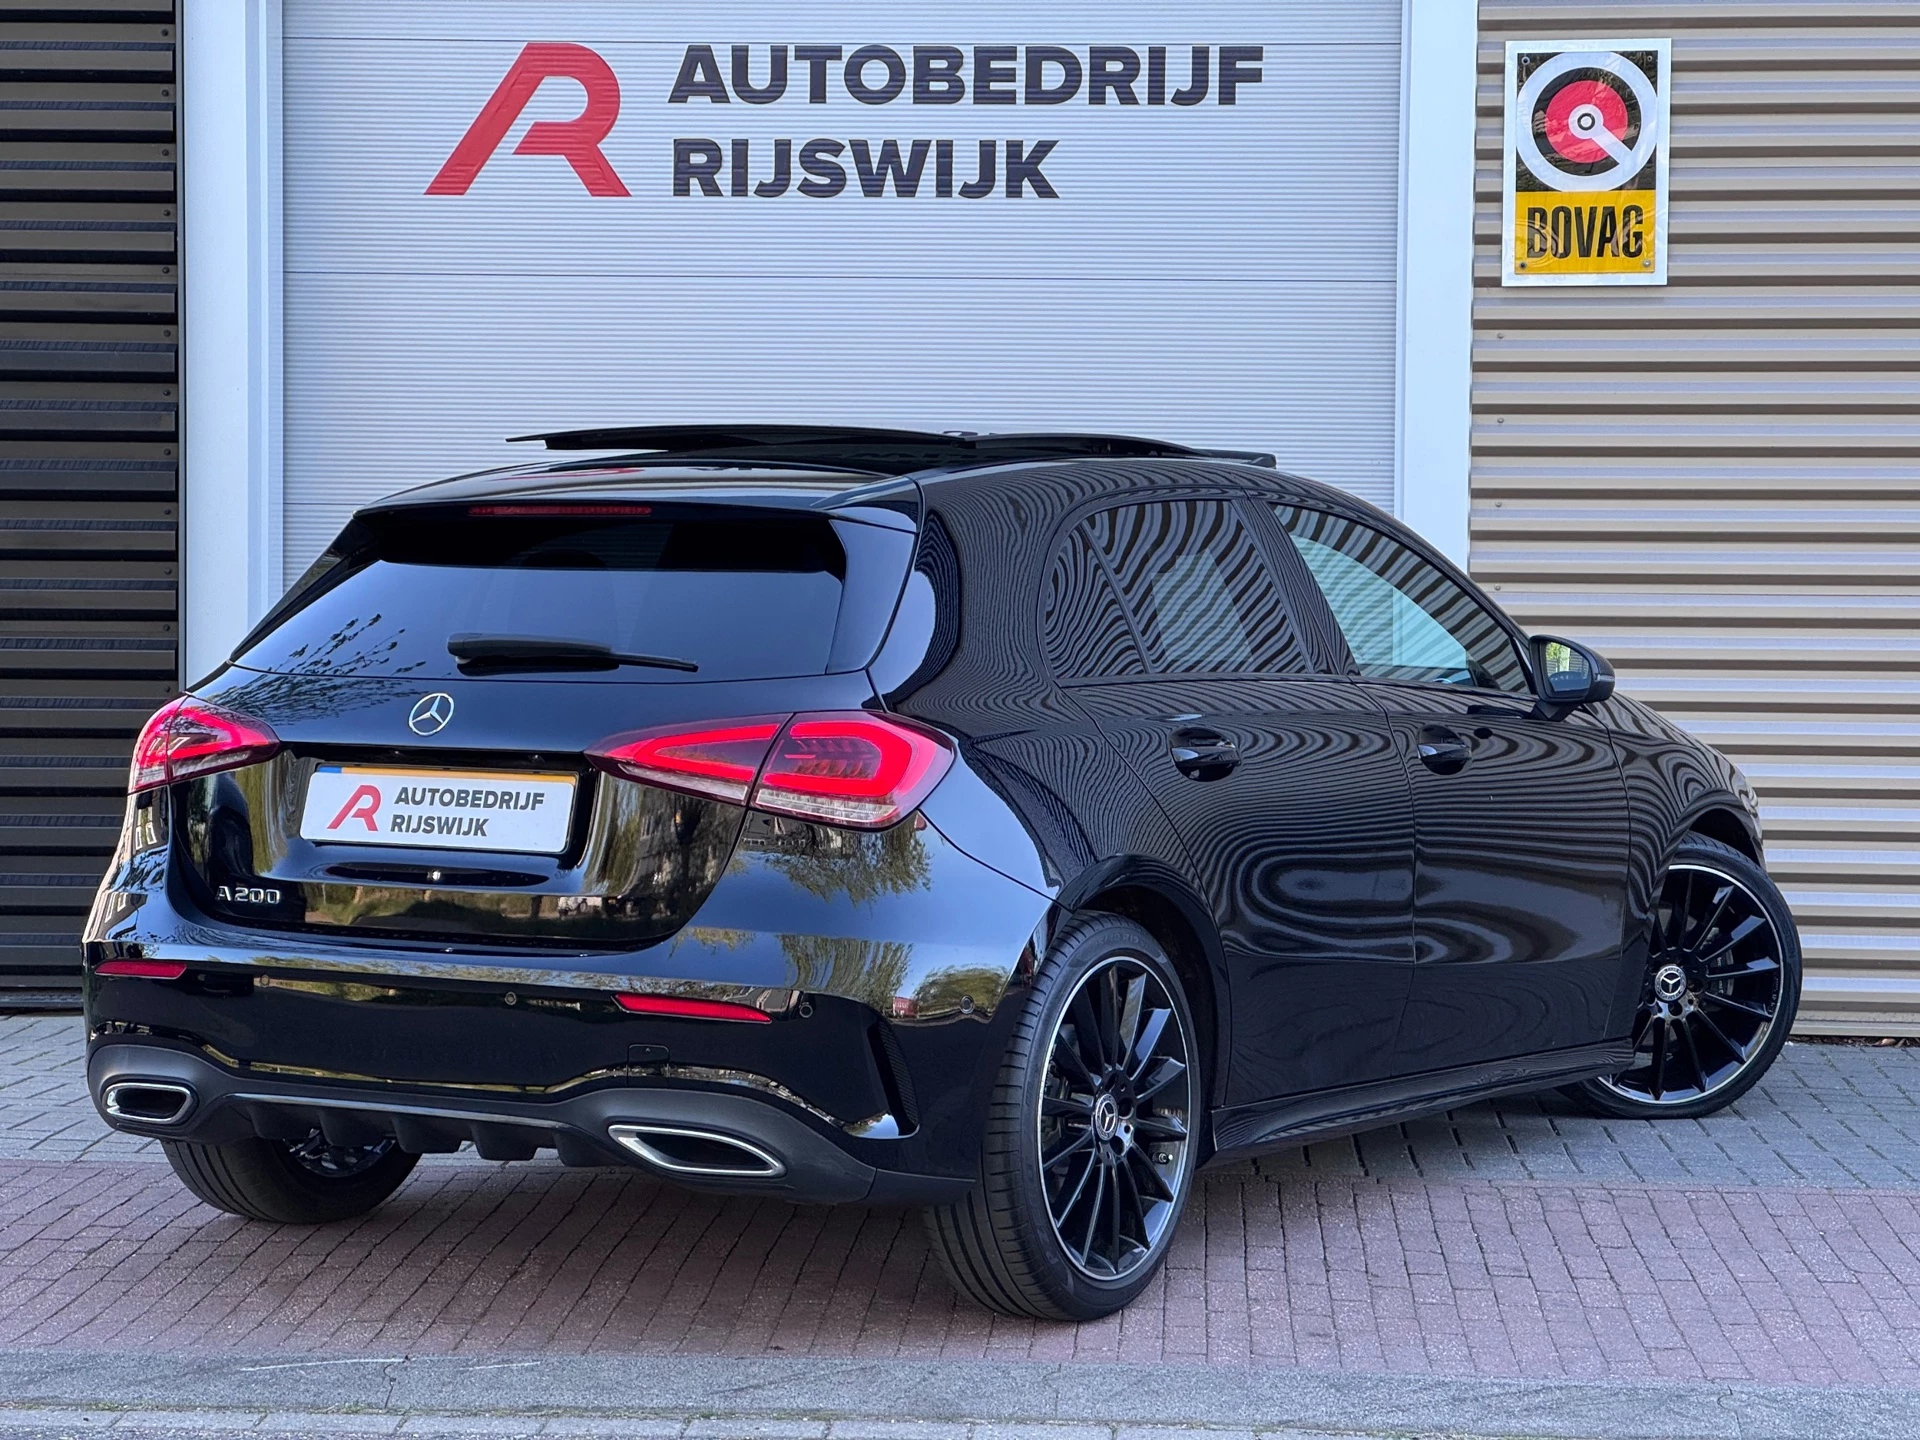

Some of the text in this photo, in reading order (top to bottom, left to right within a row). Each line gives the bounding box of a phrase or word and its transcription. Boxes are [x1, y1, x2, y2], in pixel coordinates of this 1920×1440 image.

[667, 44, 1264, 107] AUTOBEDRIJF
[672, 138, 1060, 199] RIJSWIJK
[1527, 205, 1644, 259] BOVAG
[390, 814, 490, 837] RIJSWIJK
[394, 786, 545, 811] AUTOBEDRIJF
